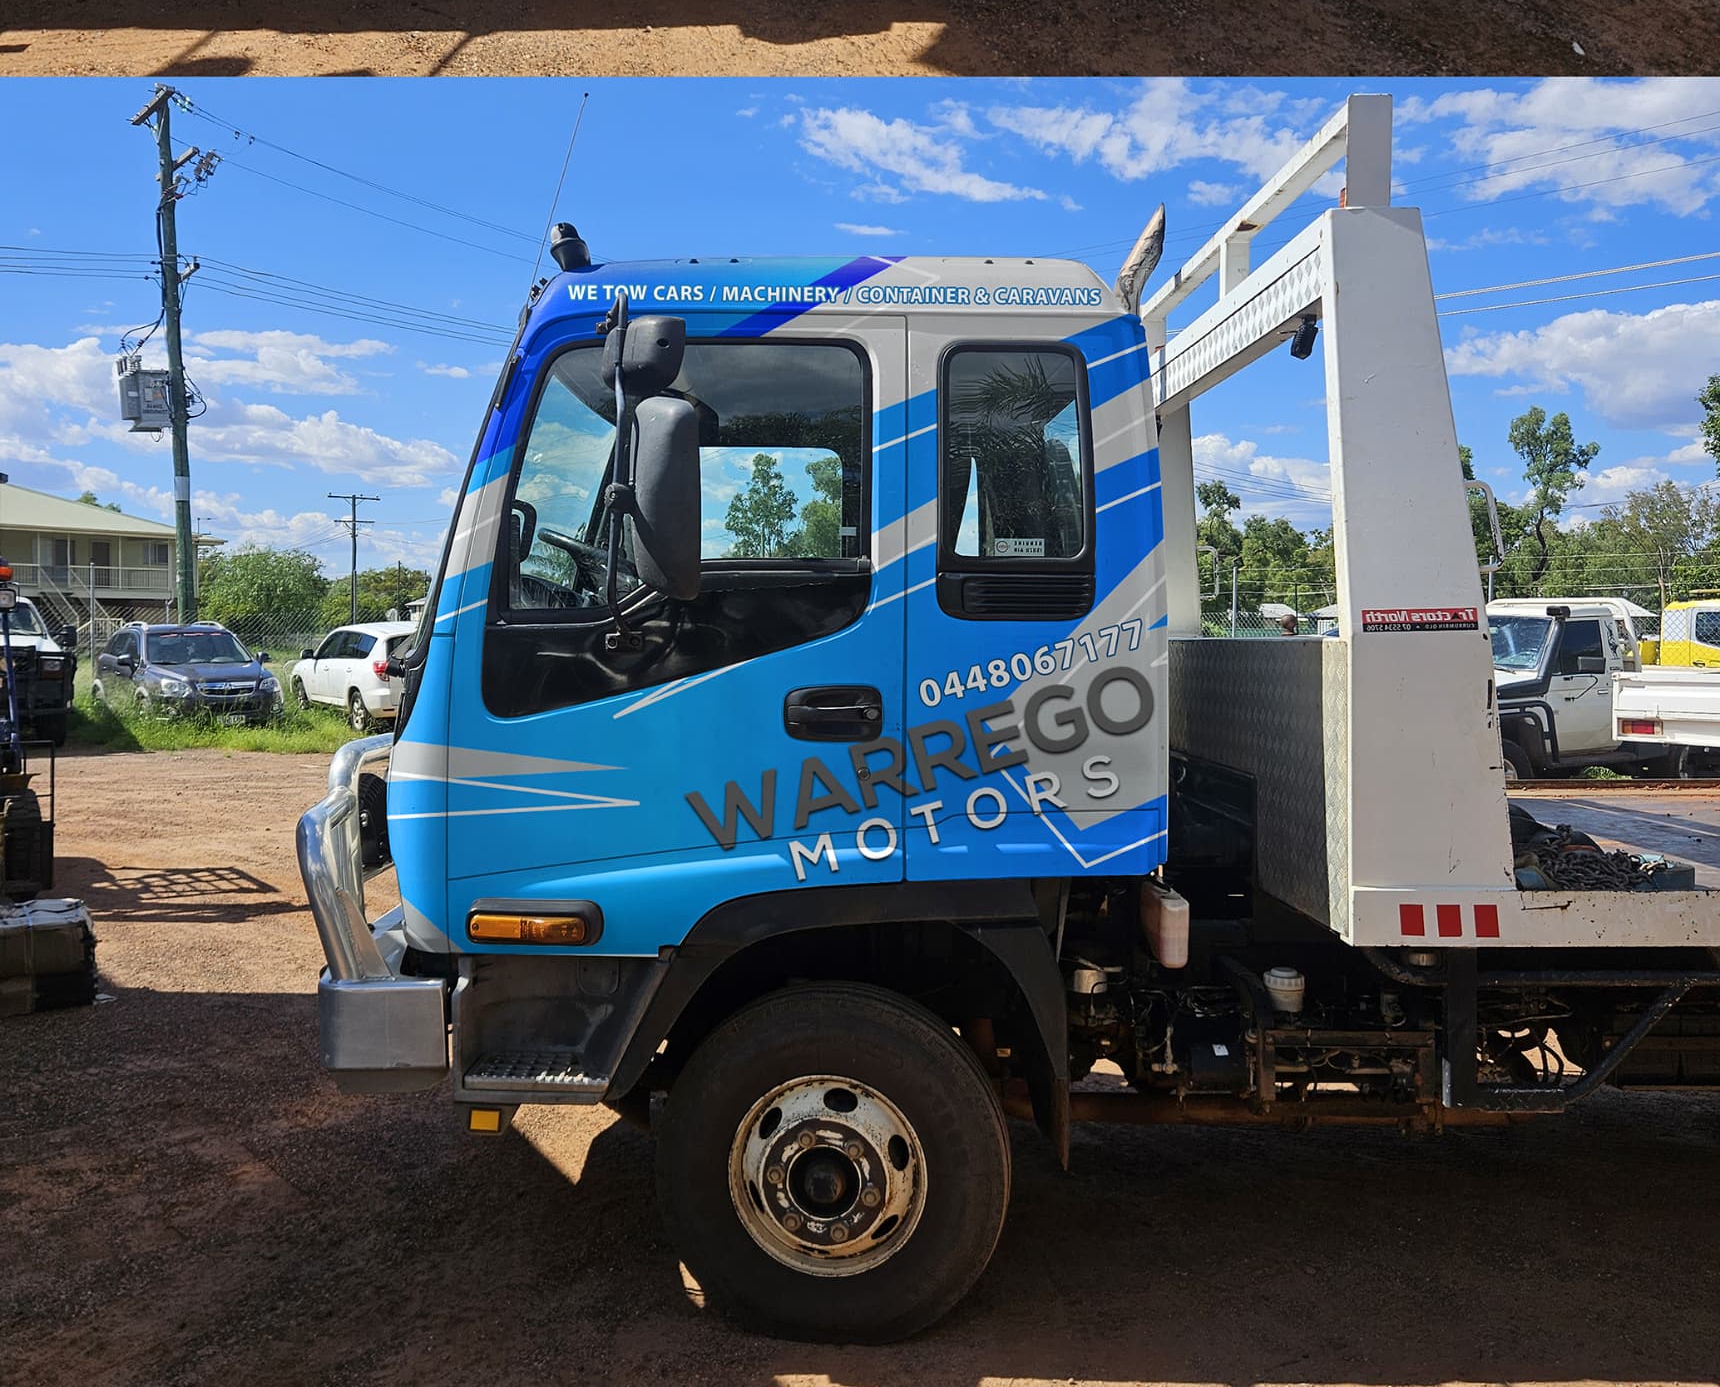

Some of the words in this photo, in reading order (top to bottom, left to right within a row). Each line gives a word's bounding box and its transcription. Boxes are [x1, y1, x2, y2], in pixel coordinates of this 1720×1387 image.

[567, 284, 598, 301] WE
[602, 284, 648, 301] TOW
[653, 285, 704, 302] CARS
[709, 285, 717, 302] /
[722, 286, 840, 304] MACHINERY
[843, 286, 852, 304] /
[856, 286, 971, 305] CONTAINER
[974, 287, 990, 305] &
[993, 287, 1102, 306] CARAVANS
[919, 618, 1143, 709] 0448067177
[685, 666, 1155, 850] WARREGO
[788, 755, 1121, 882] MOTORS
